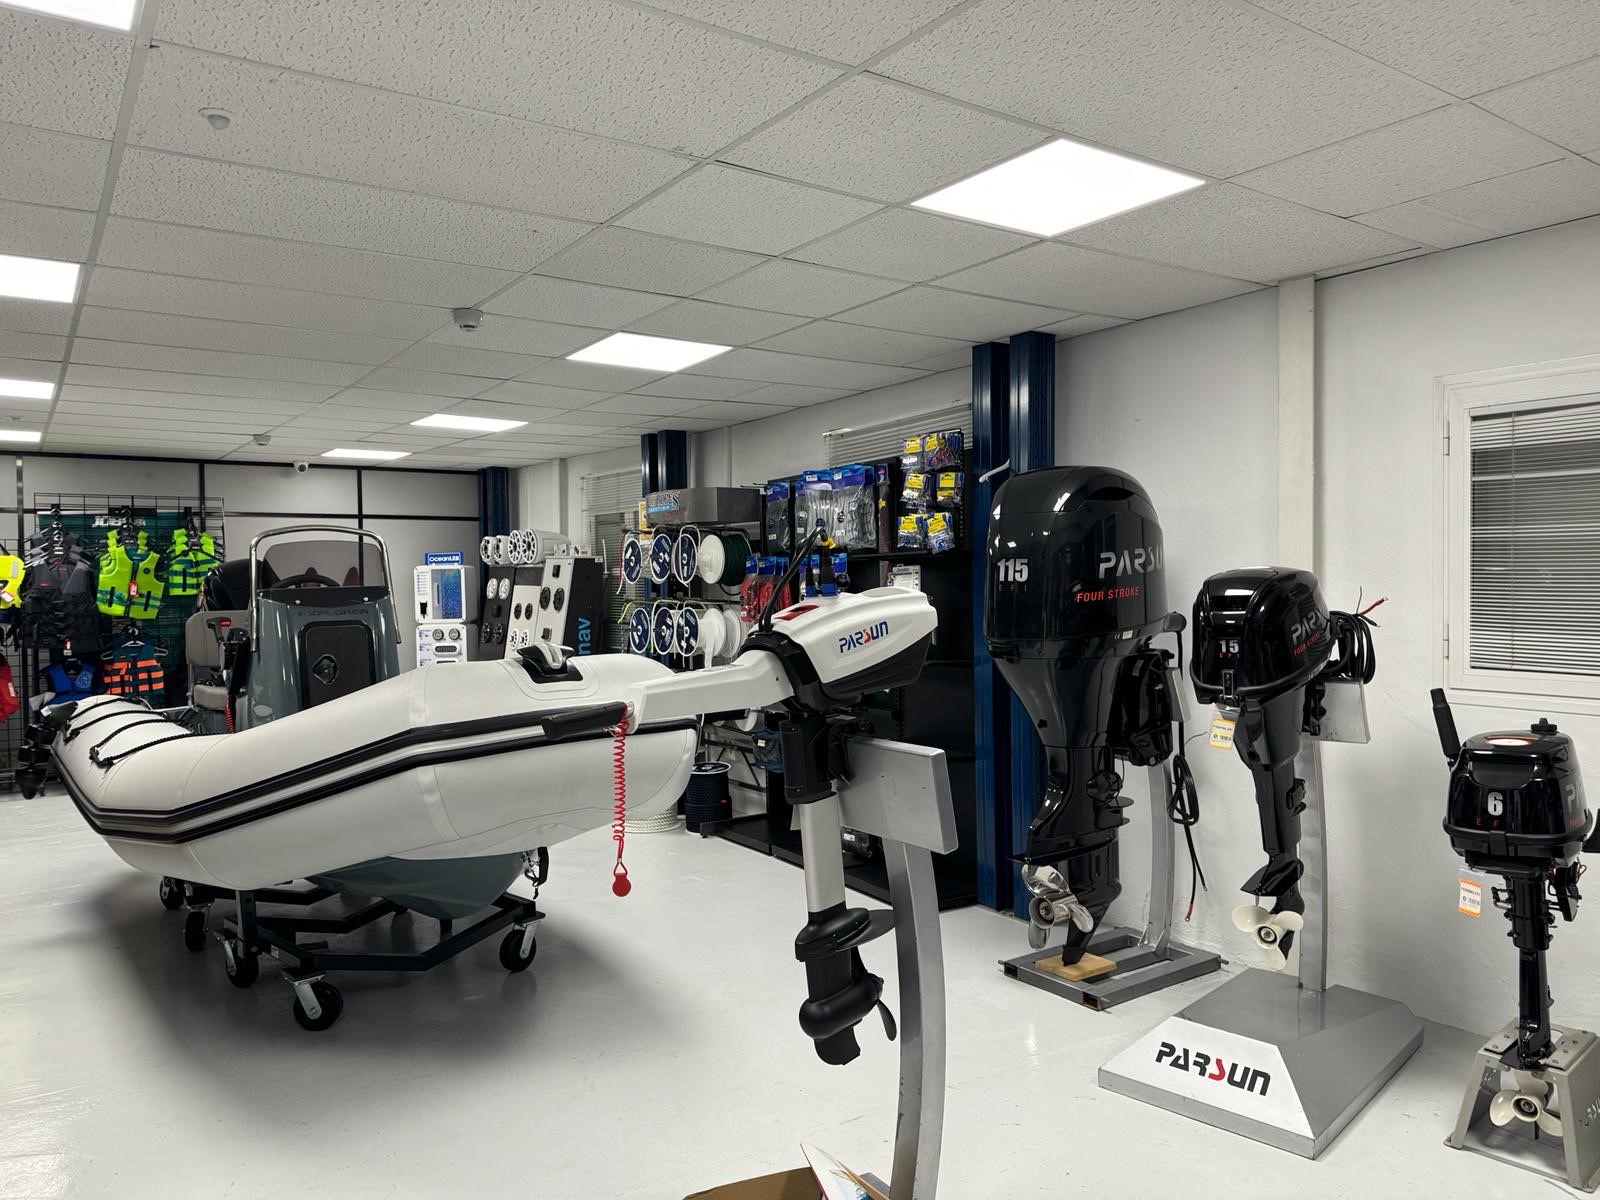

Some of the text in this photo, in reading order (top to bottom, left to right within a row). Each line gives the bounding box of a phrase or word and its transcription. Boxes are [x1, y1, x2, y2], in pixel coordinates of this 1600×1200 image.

[91, 515, 130, 528] JOB
[997, 558, 1029, 582] 115
[1099, 545, 1164, 579] PARSU
[1076, 586, 1140, 603] FOUR STROKE
[838, 620, 889, 654] PARSUN
[1219, 639, 1239, 653] 15
[1487, 791, 1504, 816] 6
[1155, 1041, 1271, 1097] PARSUN
